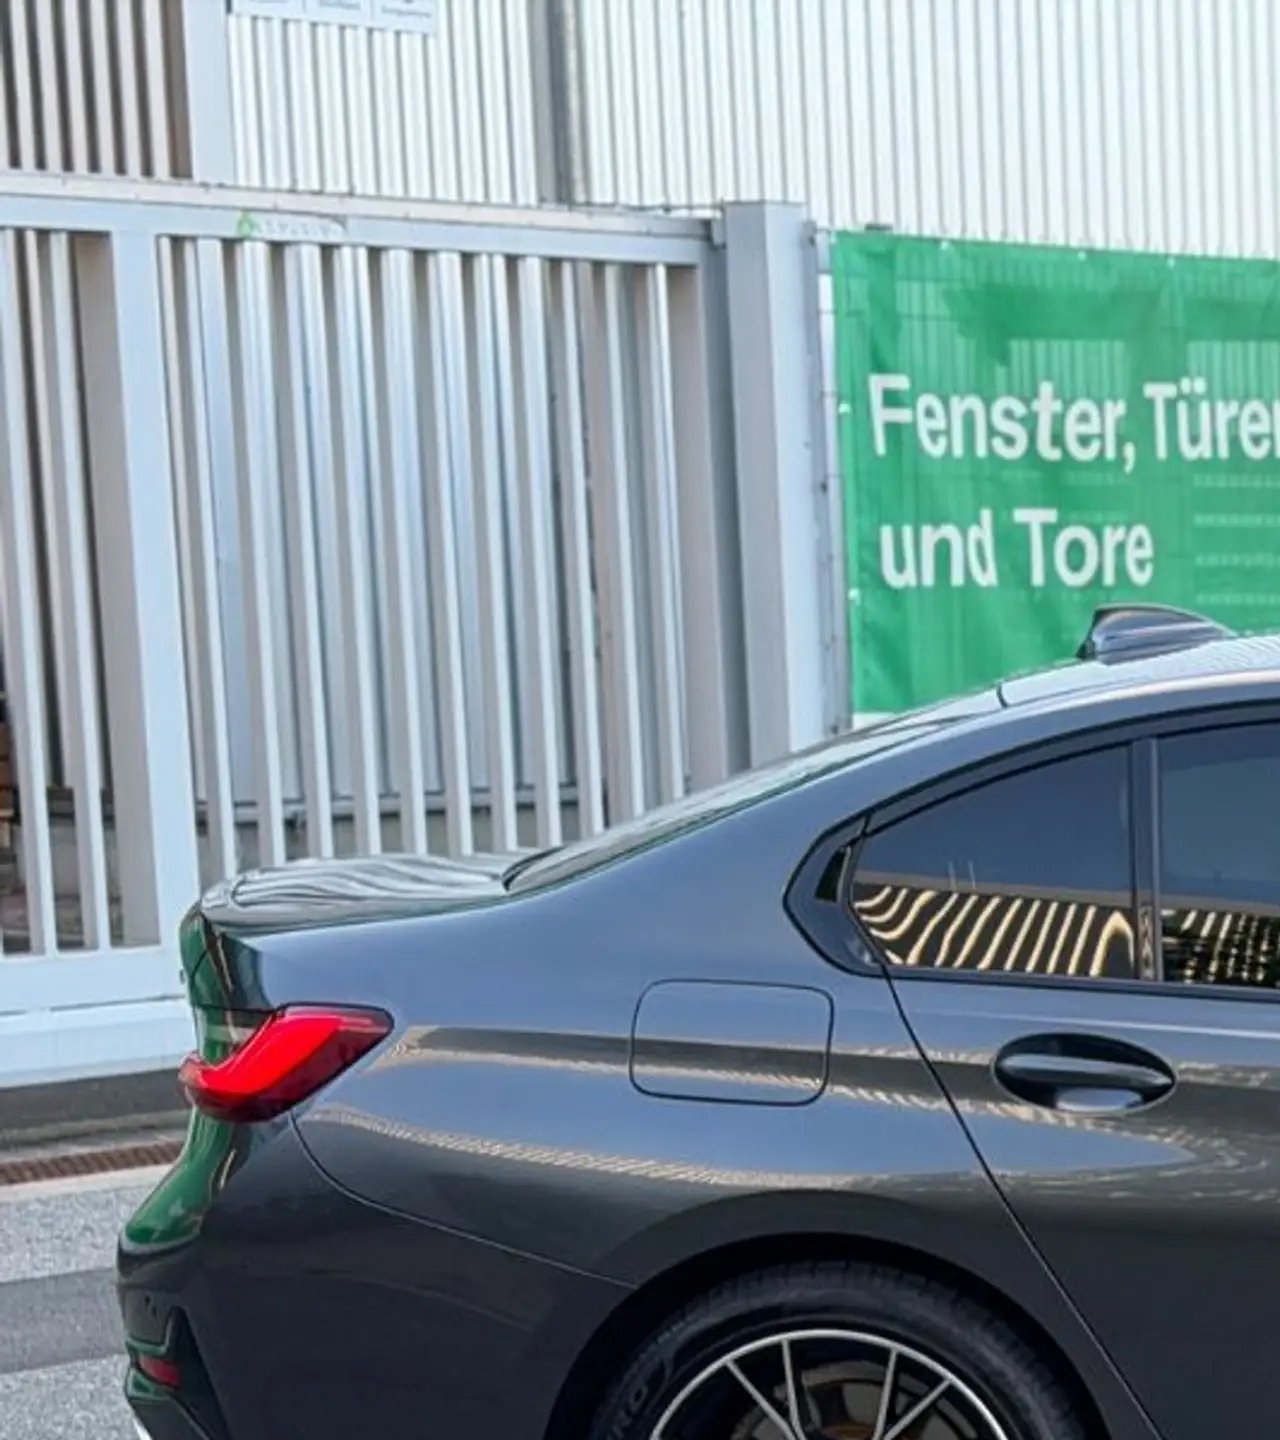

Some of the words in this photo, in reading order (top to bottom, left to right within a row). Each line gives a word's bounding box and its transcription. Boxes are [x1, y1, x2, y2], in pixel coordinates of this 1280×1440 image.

[868, 374, 1136, 474] Fenster,
[880, 508, 998, 588] und
[1013, 508, 1154, 588] Tore
